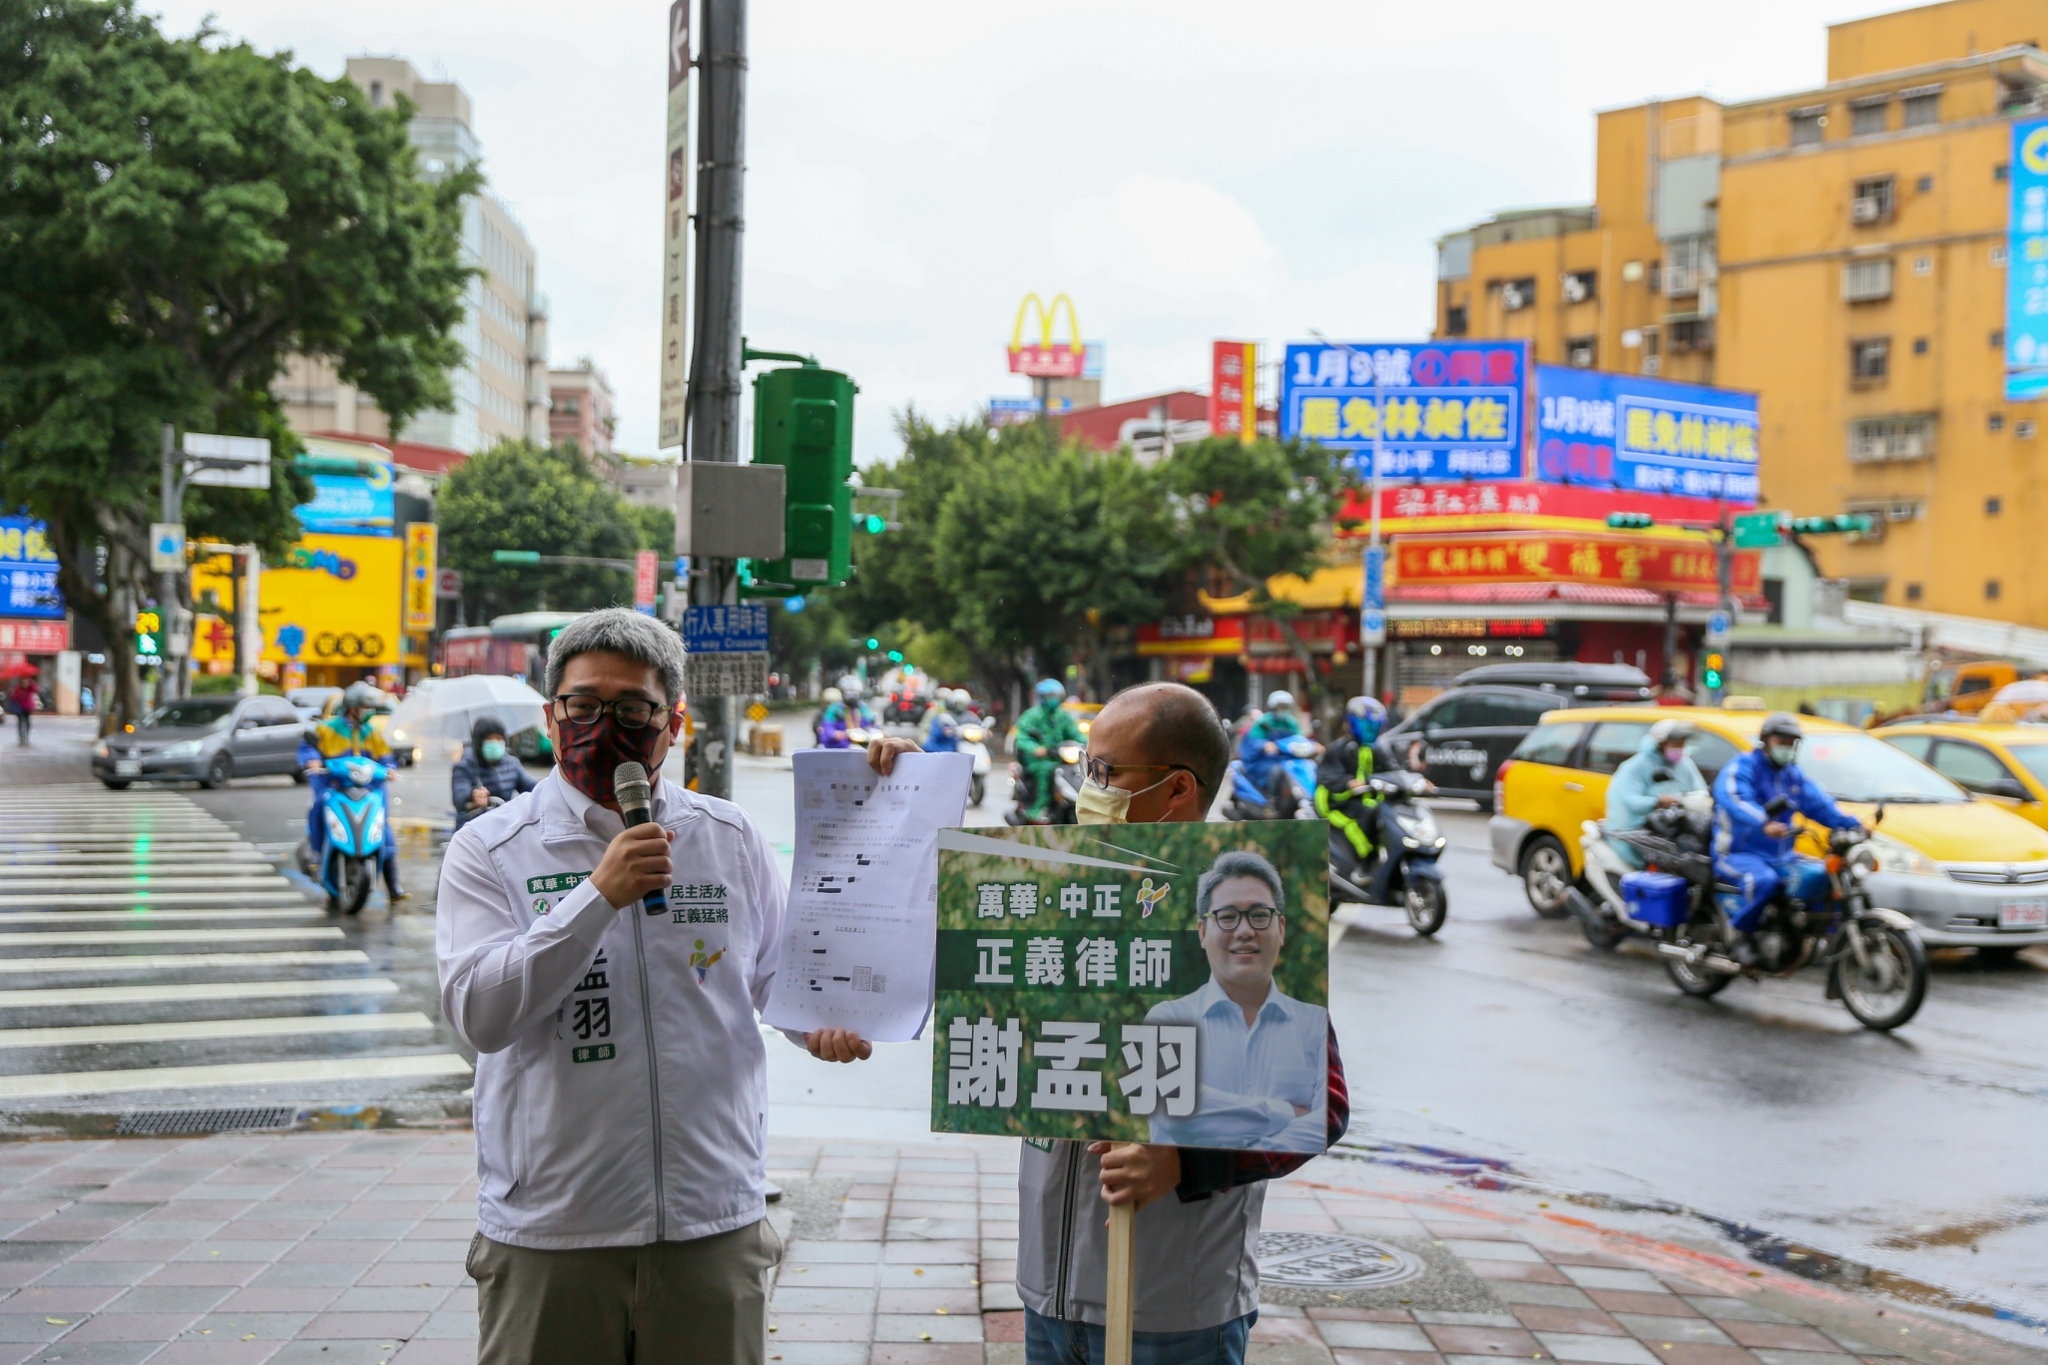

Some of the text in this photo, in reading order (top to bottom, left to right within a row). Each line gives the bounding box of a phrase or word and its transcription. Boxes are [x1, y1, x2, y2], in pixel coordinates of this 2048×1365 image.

[670, 884, 728, 899] 民主活水
[977, 883, 1122, 919] 萬華·中正
[672, 908, 729, 924] 正義猛將
[974, 936, 1172, 988] 正義律師
[577, 1046, 611, 1062] 律師
[948, 1016, 1198, 1118] 謝孟羽
